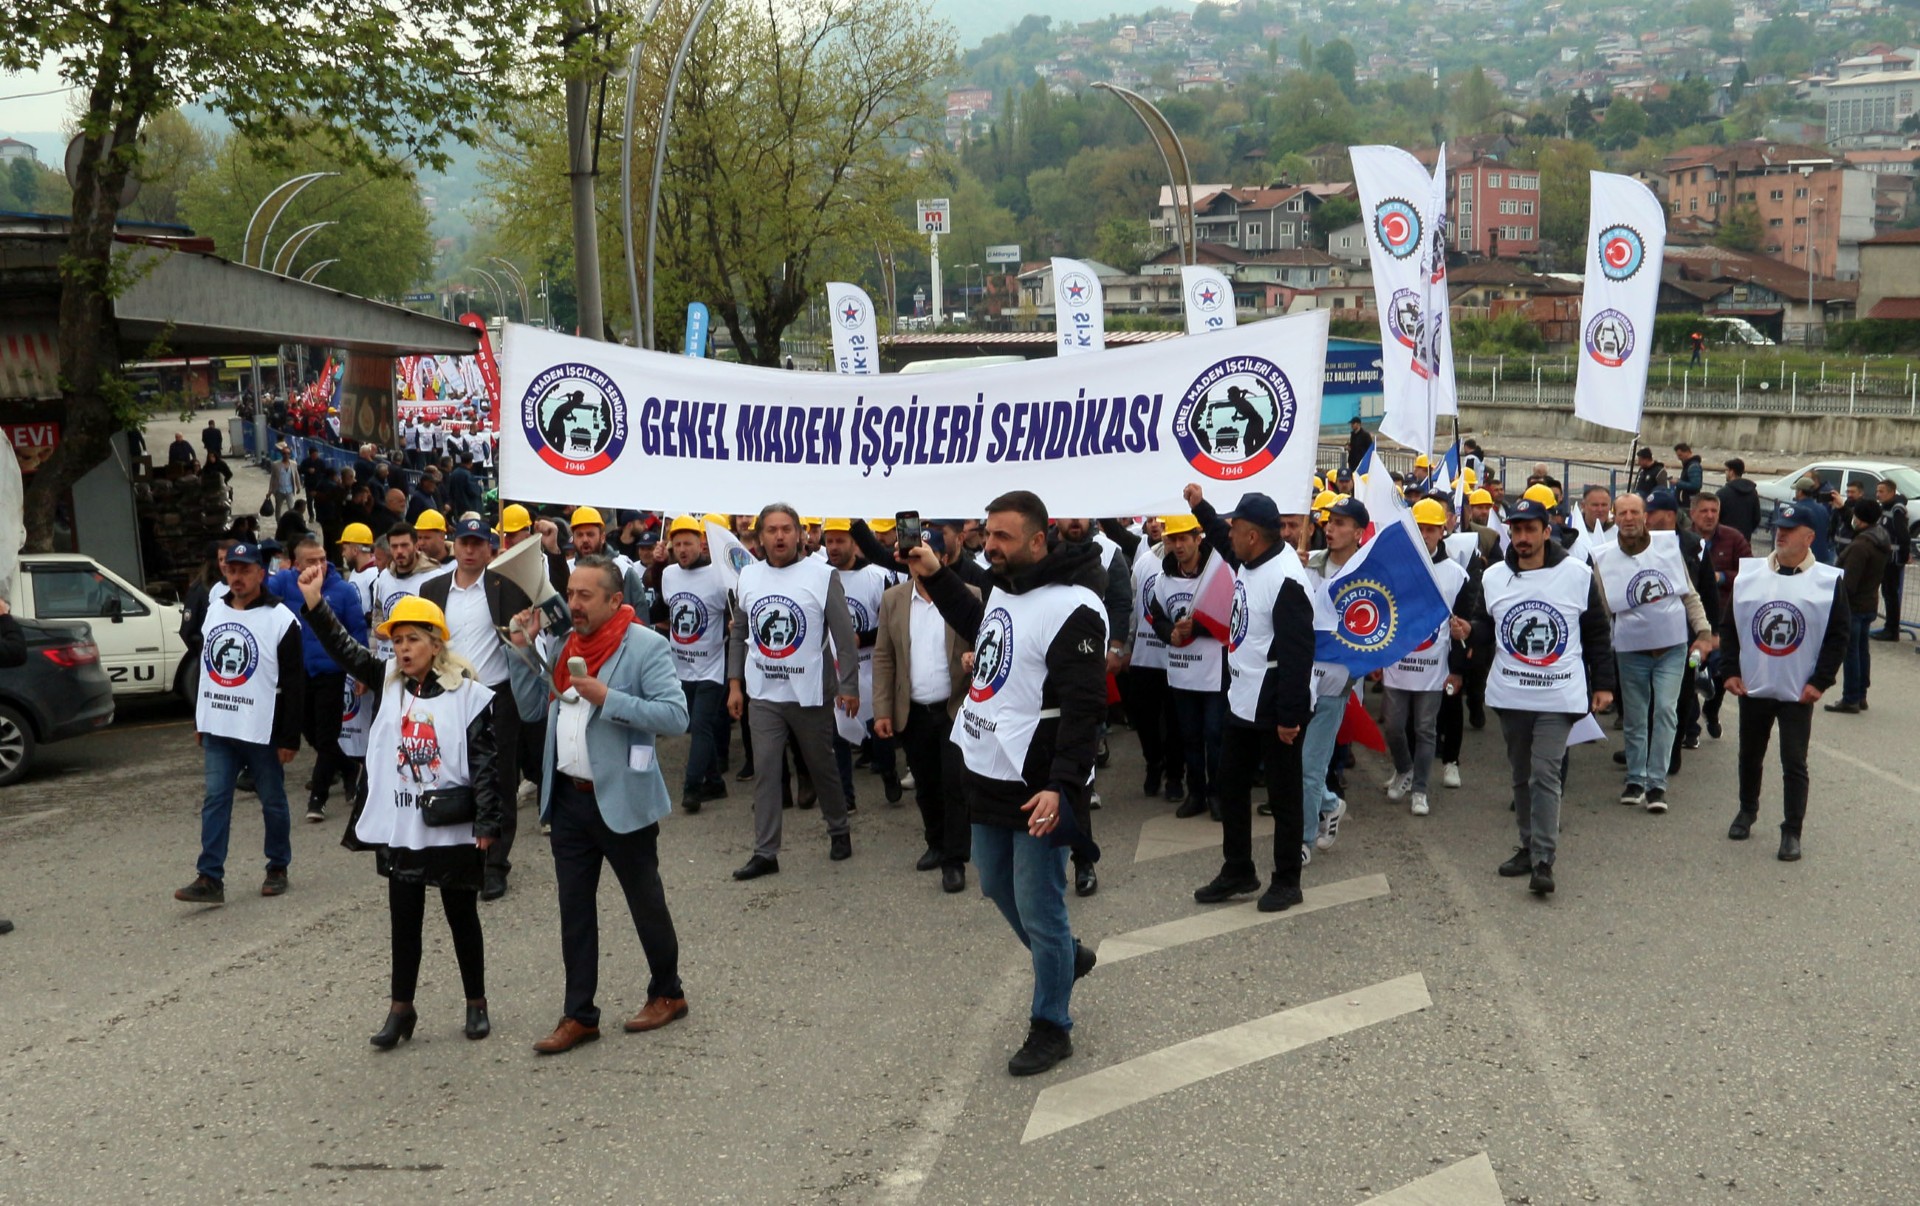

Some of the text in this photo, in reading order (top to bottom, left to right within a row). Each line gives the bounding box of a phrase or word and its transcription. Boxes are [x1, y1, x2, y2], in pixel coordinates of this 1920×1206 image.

[926, 222, 942, 231] oil
[525, 365, 625, 441] GENEL MADEN İŞÇİLERİ SENDİKASI
[1176, 358, 1293, 437] GENEL MADEN İŞÇİLERİ SENDİKASI
[640, 388, 1163, 477] GENEL MADEN İŞÇİLERİ SENDİKASI
[565, 461, 586, 471] 1946
[1220, 466, 1243, 475] 1946
[999, 628, 1011, 679] SENDİKASI
[107, 665, 154, 682] ZU
[231, 694, 254, 705] İŞÇİLERİ
[413, 722, 419, 736] 1
